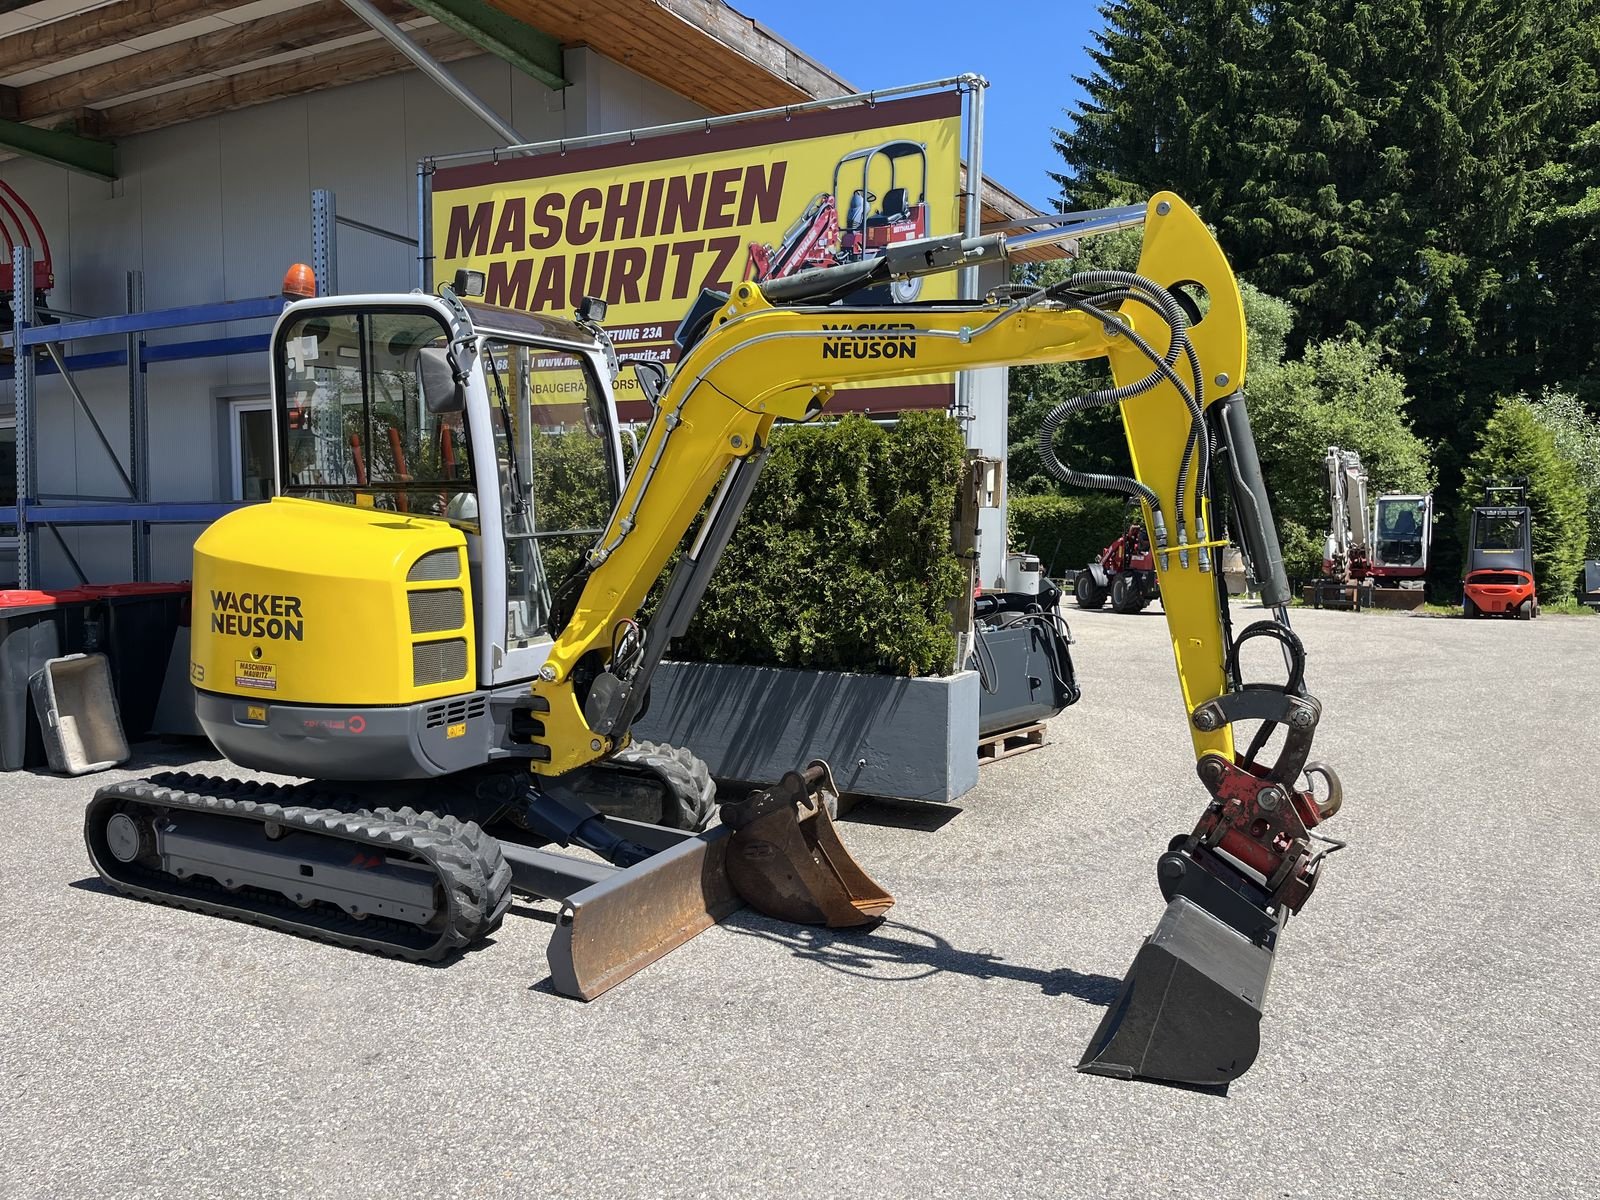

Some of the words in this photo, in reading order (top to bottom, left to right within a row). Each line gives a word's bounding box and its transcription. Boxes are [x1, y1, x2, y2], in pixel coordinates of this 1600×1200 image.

[444, 160, 788, 261] MASCHINEN
[483, 235, 741, 313] MAURITZ
[641, 326, 663, 340] 23A
[822, 323, 917, 341] WACKER
[822, 341, 917, 359] NEUSON
[210, 589, 304, 618] WACKER
[211, 612, 304, 642] NEUSON
[239, 662, 273, 673] MASCHINEN
[243, 669, 269, 679] MAURITZ
